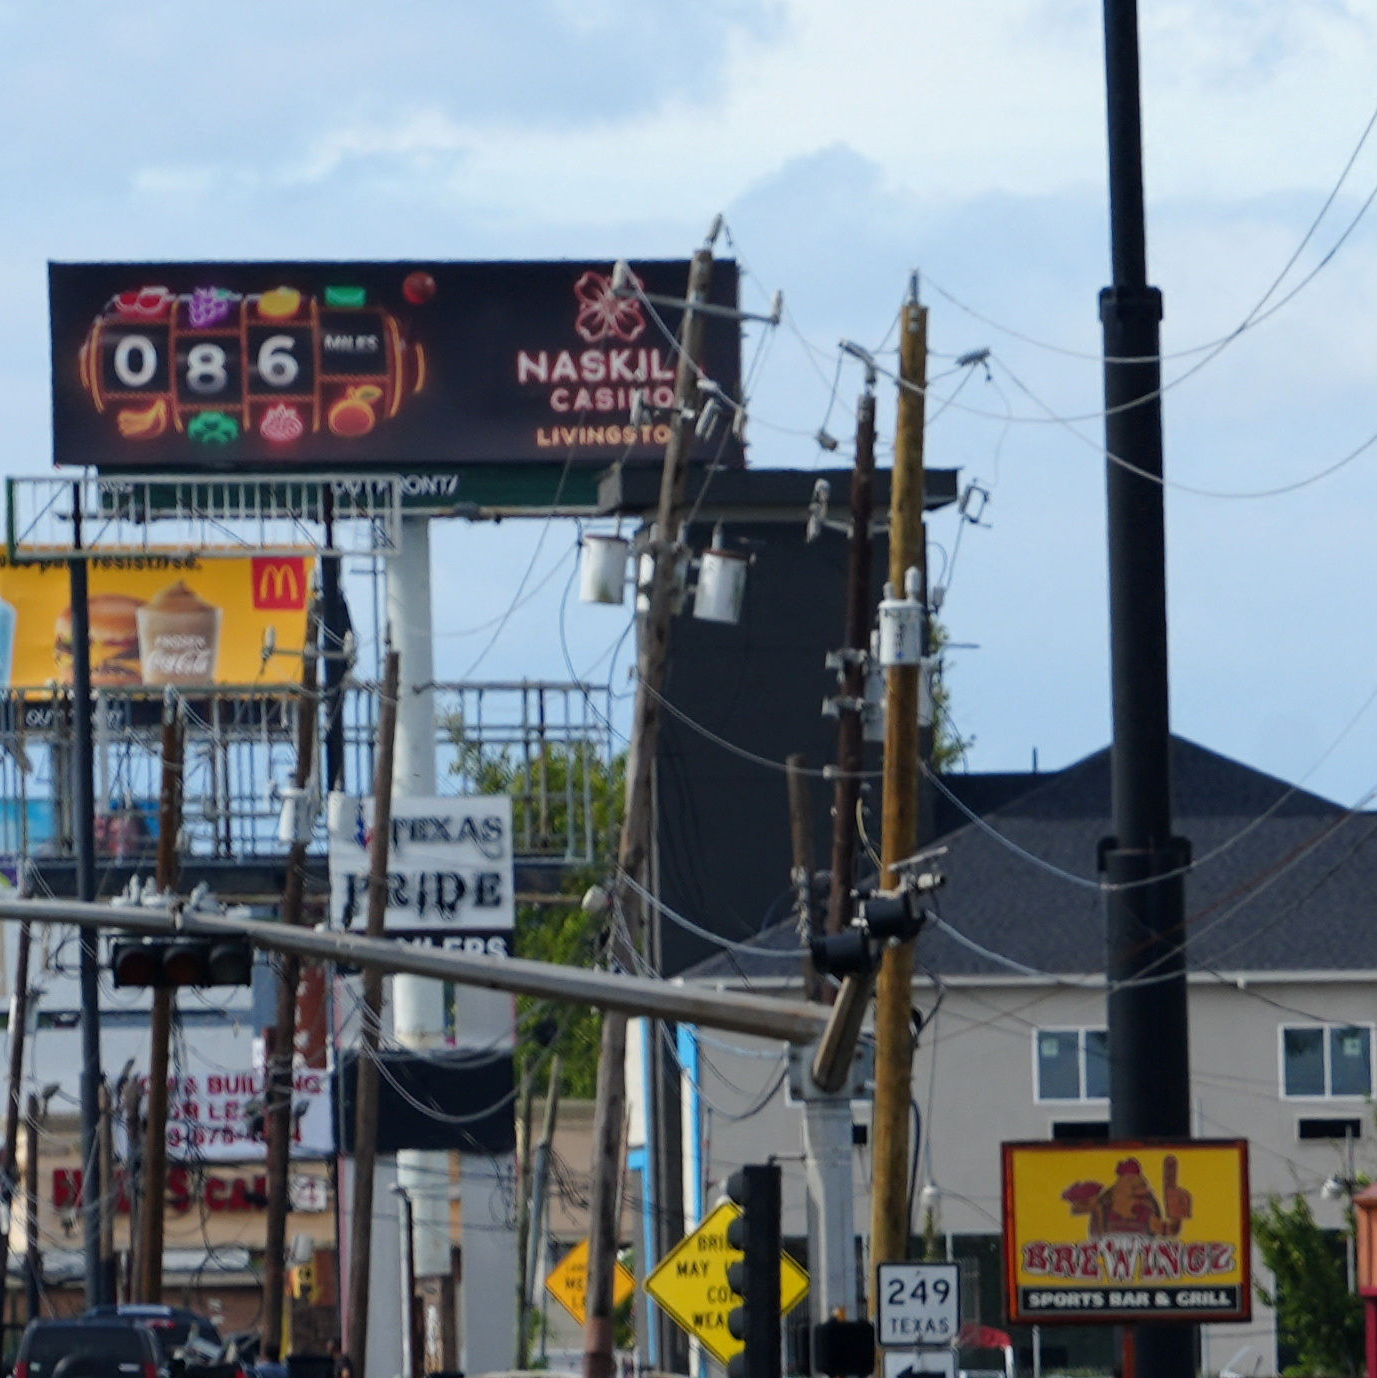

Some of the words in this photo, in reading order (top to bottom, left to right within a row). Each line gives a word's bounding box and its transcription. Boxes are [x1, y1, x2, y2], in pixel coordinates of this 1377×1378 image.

[324, 334, 379, 352] MILES
[516, 349, 675, 383] NASKIL
[536, 424, 673, 448] LIVINGSTO
[391, 816, 504, 860] TEXAS
[1023, 1238, 1236, 1281] BREWINGZ
[888, 1278, 950, 1306] 249
[1028, 1291, 1105, 1308] SPORTS
[1109, 1290, 1150, 1307] BAR
[1154, 1291, 1170, 1307] &
[1175, 1290, 1231, 1307] GRILL
[889, 1316, 950, 1335] TEXAS
